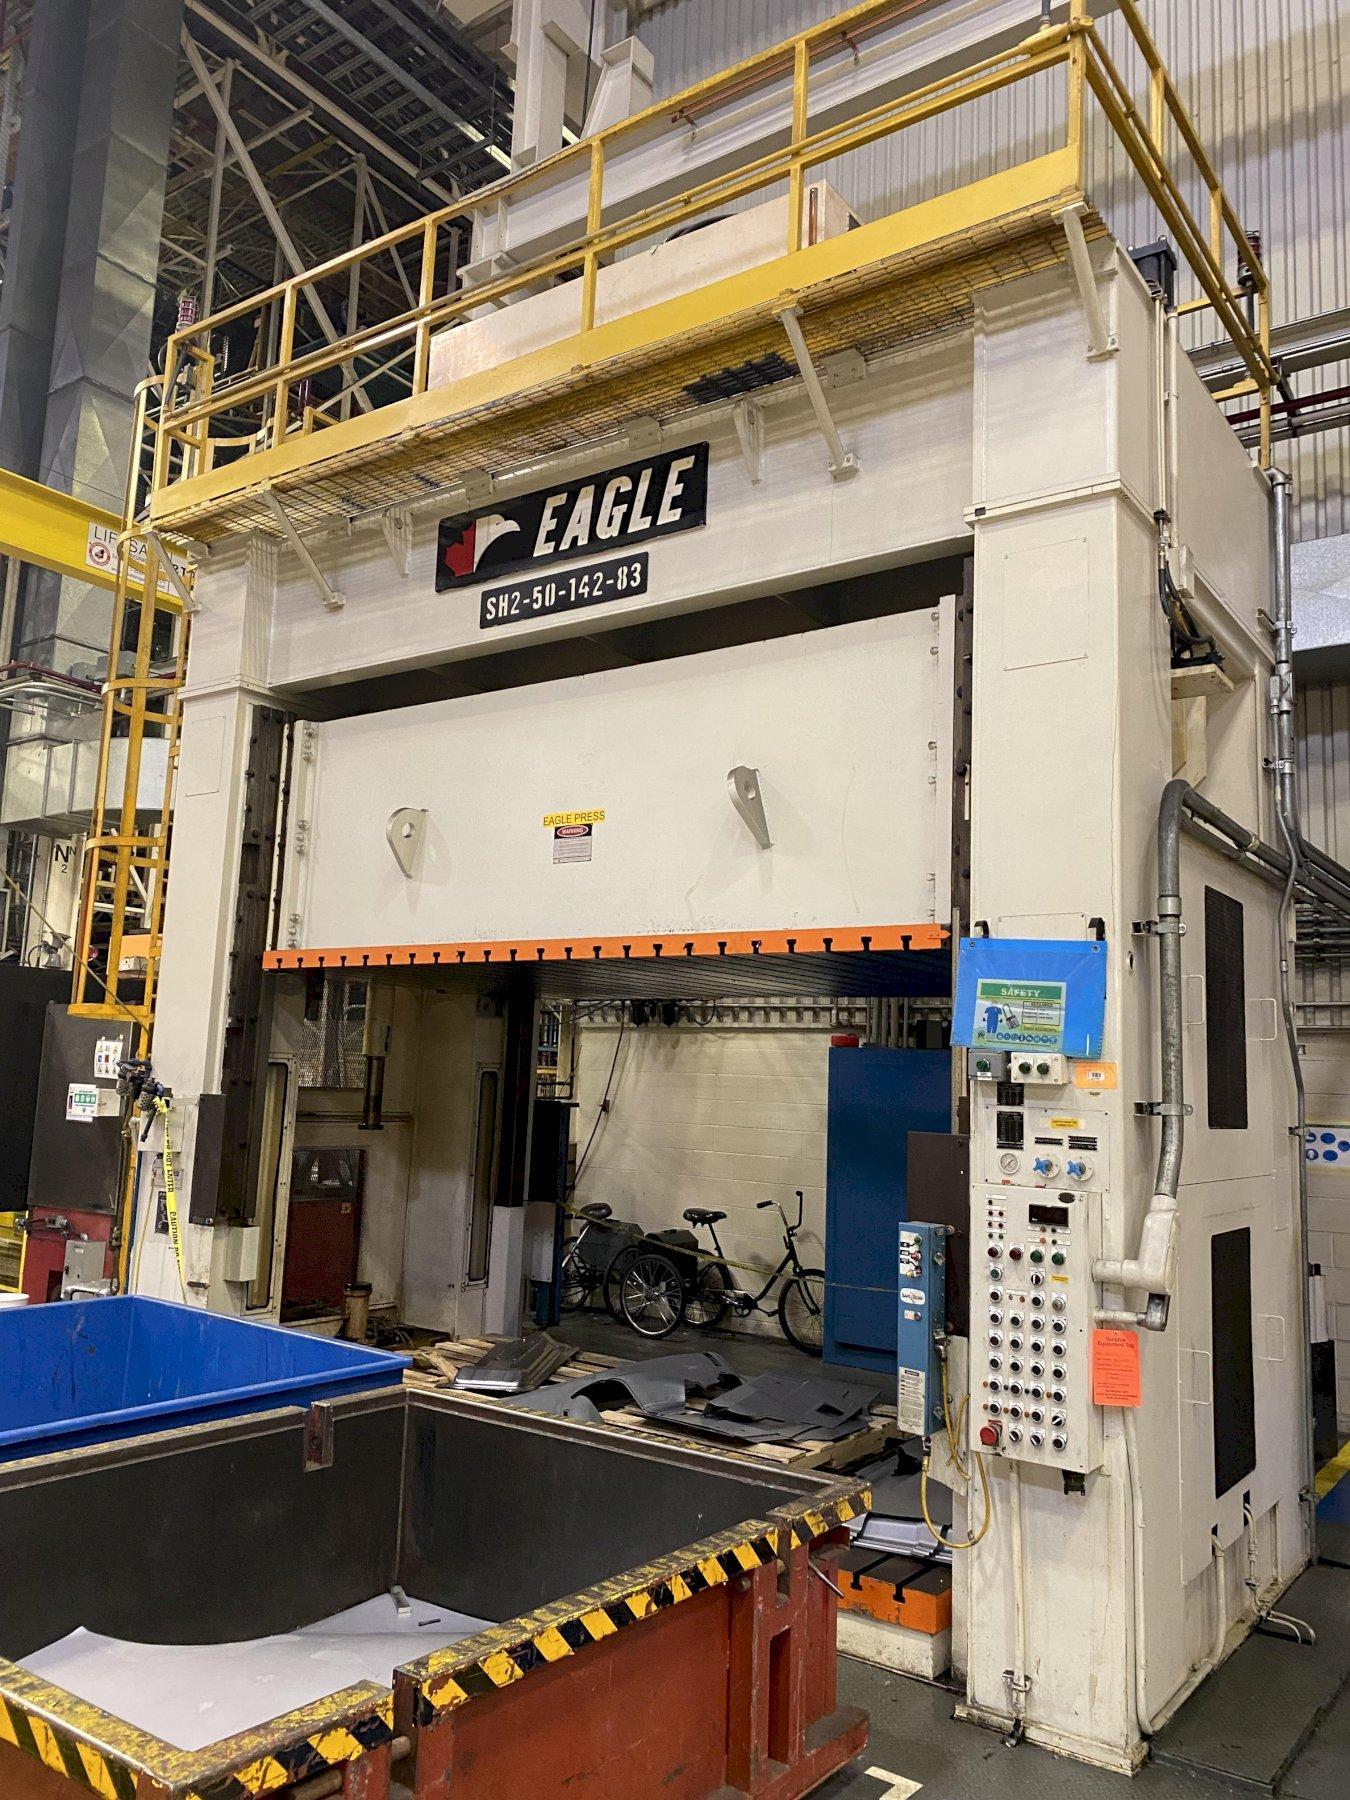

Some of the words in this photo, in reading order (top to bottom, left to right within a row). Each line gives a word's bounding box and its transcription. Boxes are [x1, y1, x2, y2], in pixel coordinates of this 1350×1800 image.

[532, 455, 696, 558] EAGLE
[485, 562, 642, 621] SH2-50-142-83
[543, 814, 572, 826] EAGLE
[574, 811, 605, 822] PRESS
[54, 844, 70, 863] N
[61, 863, 68, 874] 2
[1000, 987, 1040, 998] SAFETY
[167, 1169, 175, 1193] ENTER
[170, 1211, 179, 1245] CAUTION
